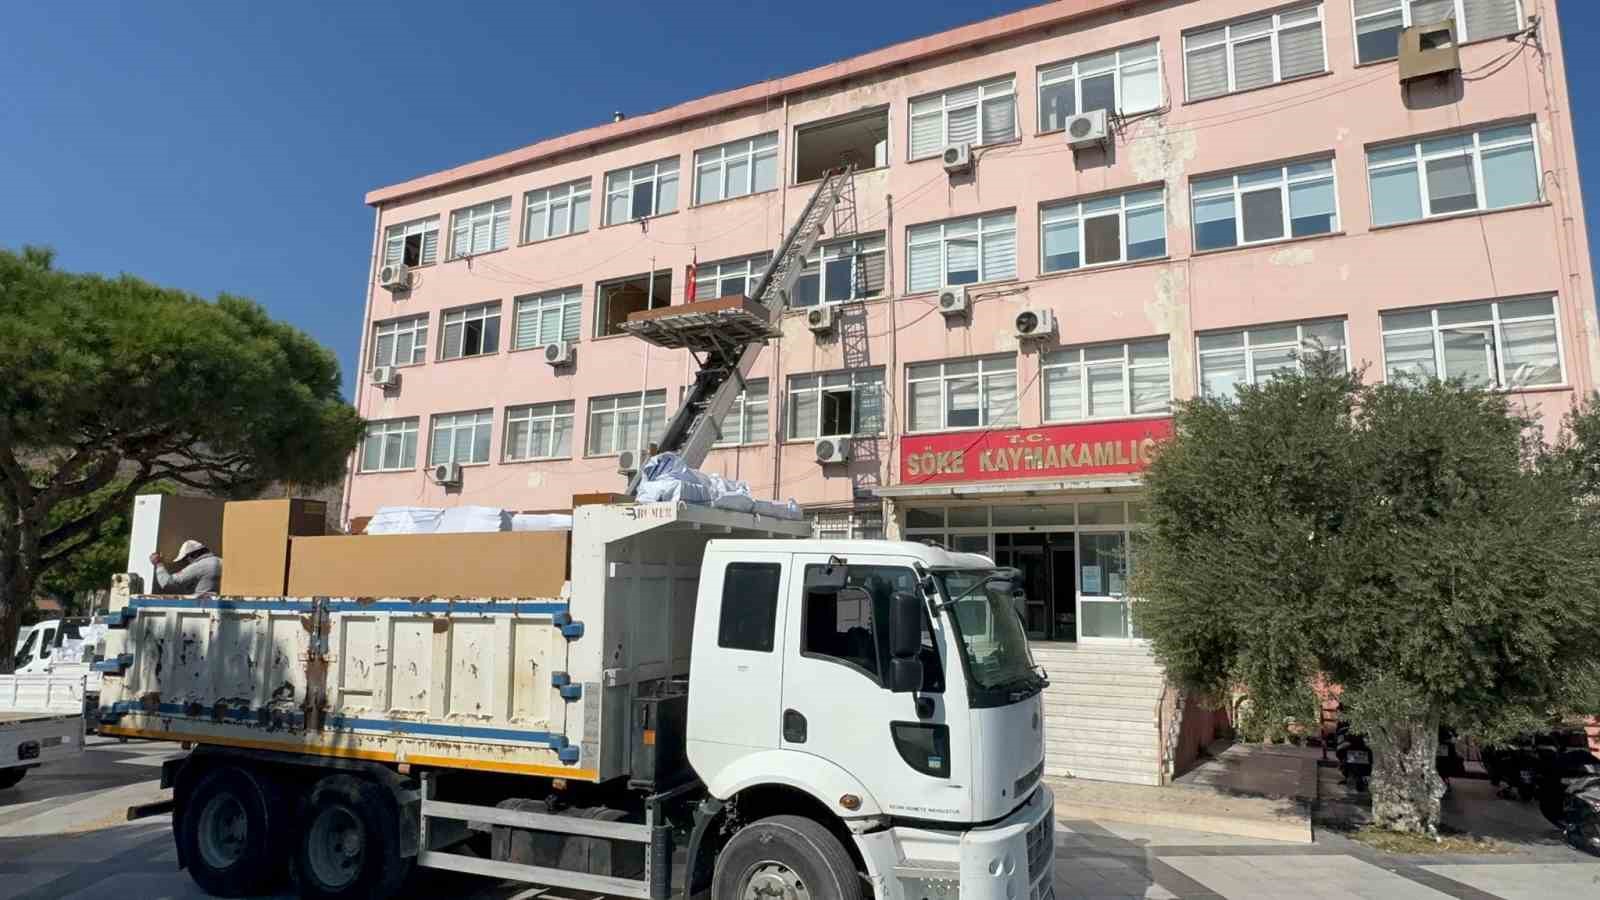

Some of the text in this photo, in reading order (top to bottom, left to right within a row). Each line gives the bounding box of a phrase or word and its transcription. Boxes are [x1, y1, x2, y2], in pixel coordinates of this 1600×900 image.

[1004, 433, 1052, 443] T.C.
[906, 431, 1158, 475] SÖKE KAYMAKAMLIĞ
